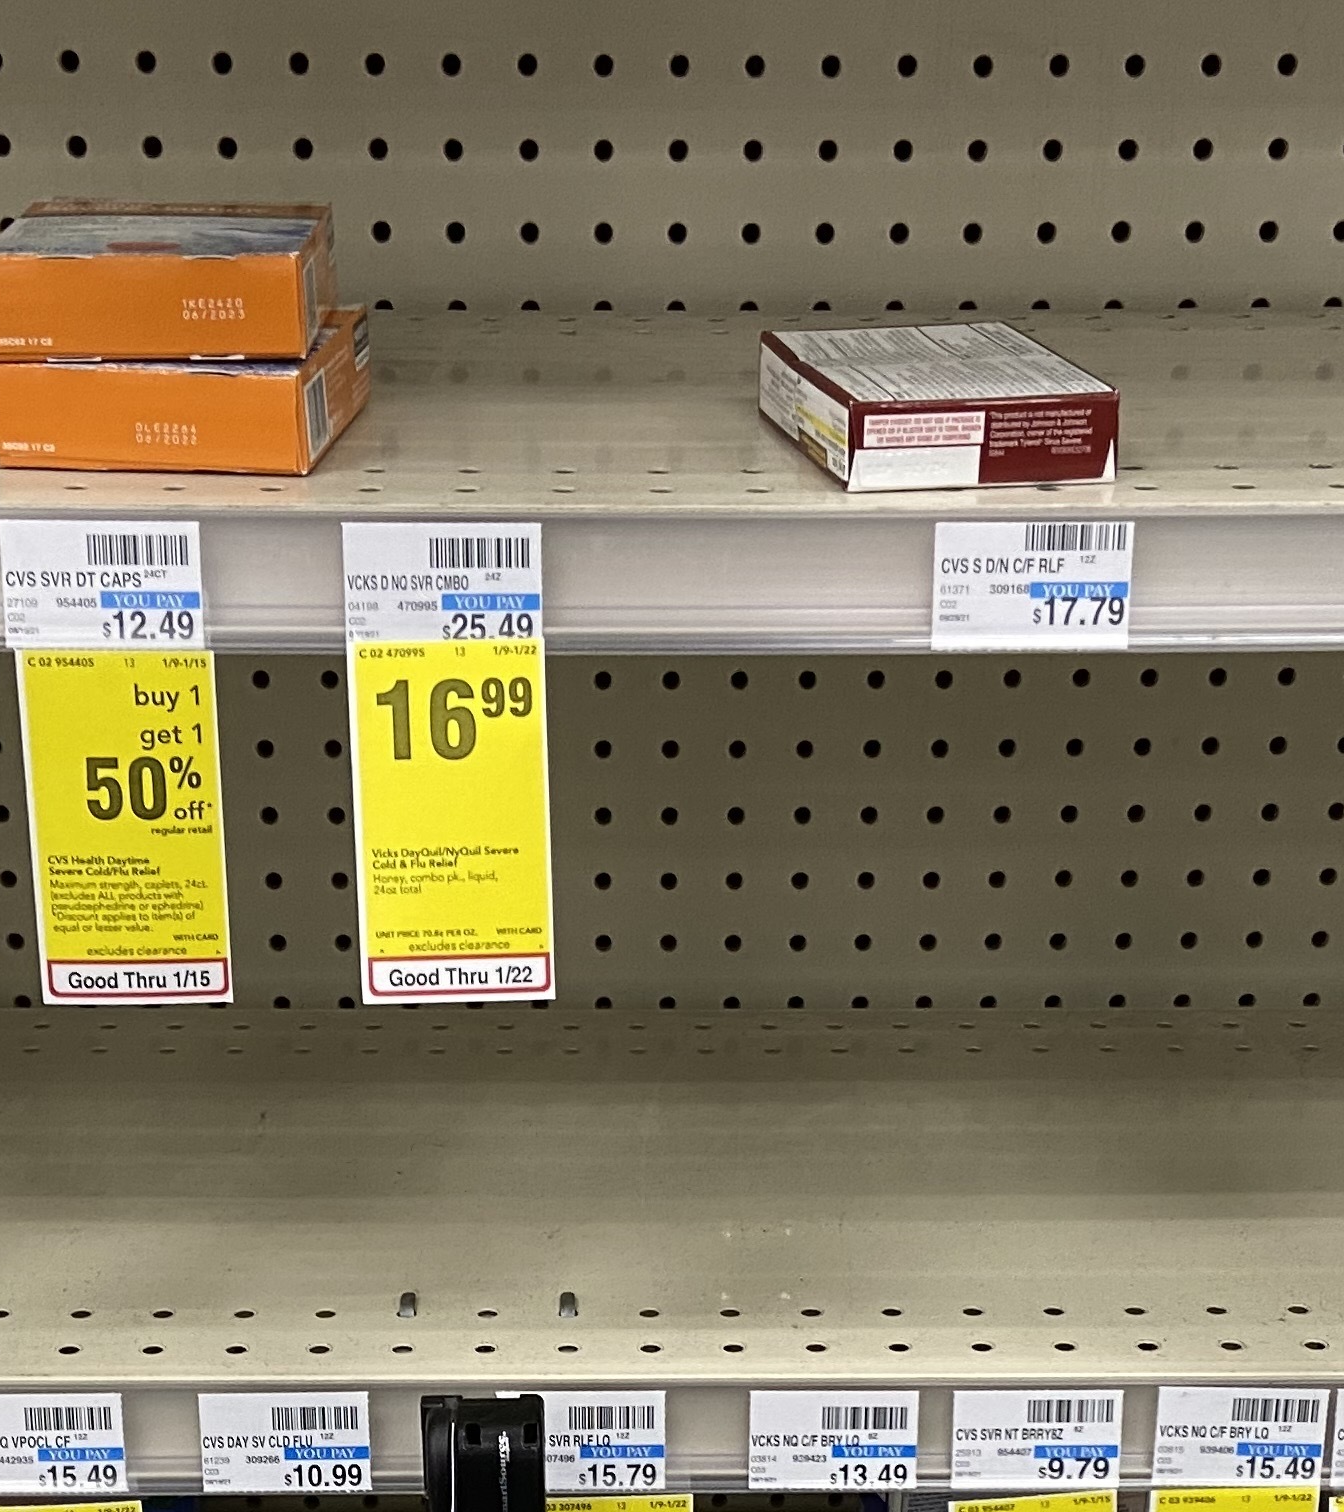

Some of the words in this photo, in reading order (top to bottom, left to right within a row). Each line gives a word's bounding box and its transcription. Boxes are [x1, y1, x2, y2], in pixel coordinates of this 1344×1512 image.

[942, 558, 969, 573] CVS
[973, 558, 981, 573] S
[986, 558, 1008, 573] D/N
[1013, 558, 1034, 573] C/F
[1039, 558, 1064, 573] RLF
[348, 575, 378, 590] VCKS
[381, 575, 388, 590] D
[392, 575, 407, 590] NQ
[411, 575, 432, 590] SVR
[436, 575, 468, 590] CMBO
[1033, 594, 1128, 625] $17.79
[103, 610, 193, 639] $12.49
[443, 613, 533, 639] $25.49
[55, 1436, 71, 1450] CF
[39, 1465, 117, 1486] $15.49
[285, 1464, 362, 1487] $10.99
[1034, 1453, 1114, 1479] $9.79
[1236, 1453, 1319, 1479] $15.49
